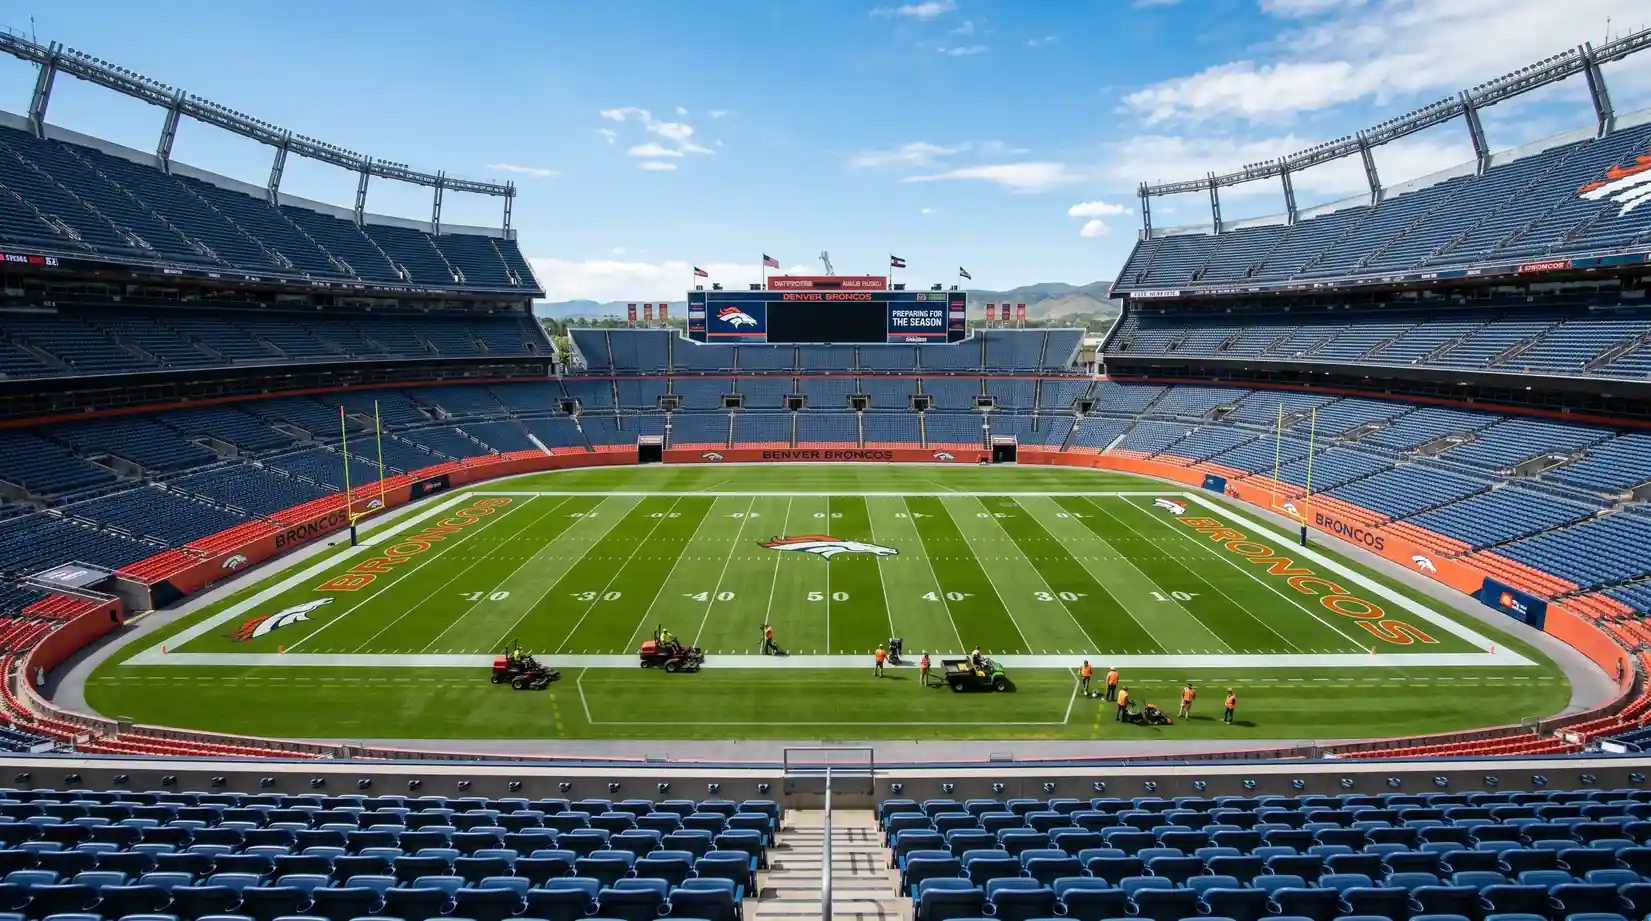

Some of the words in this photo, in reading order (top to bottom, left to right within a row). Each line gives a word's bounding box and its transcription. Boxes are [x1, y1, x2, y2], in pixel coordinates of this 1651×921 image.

[892, 318, 909, 326] THE
[909, 318, 942, 327] SEASON
[823, 451, 893, 459] BRONCOS
[275, 509, 347, 549] BRONCOS
[312, 497, 513, 592] BRONCOS
[1315, 511, 1385, 551] BRONCOS
[1176, 516, 1441, 645] BRONCOS
